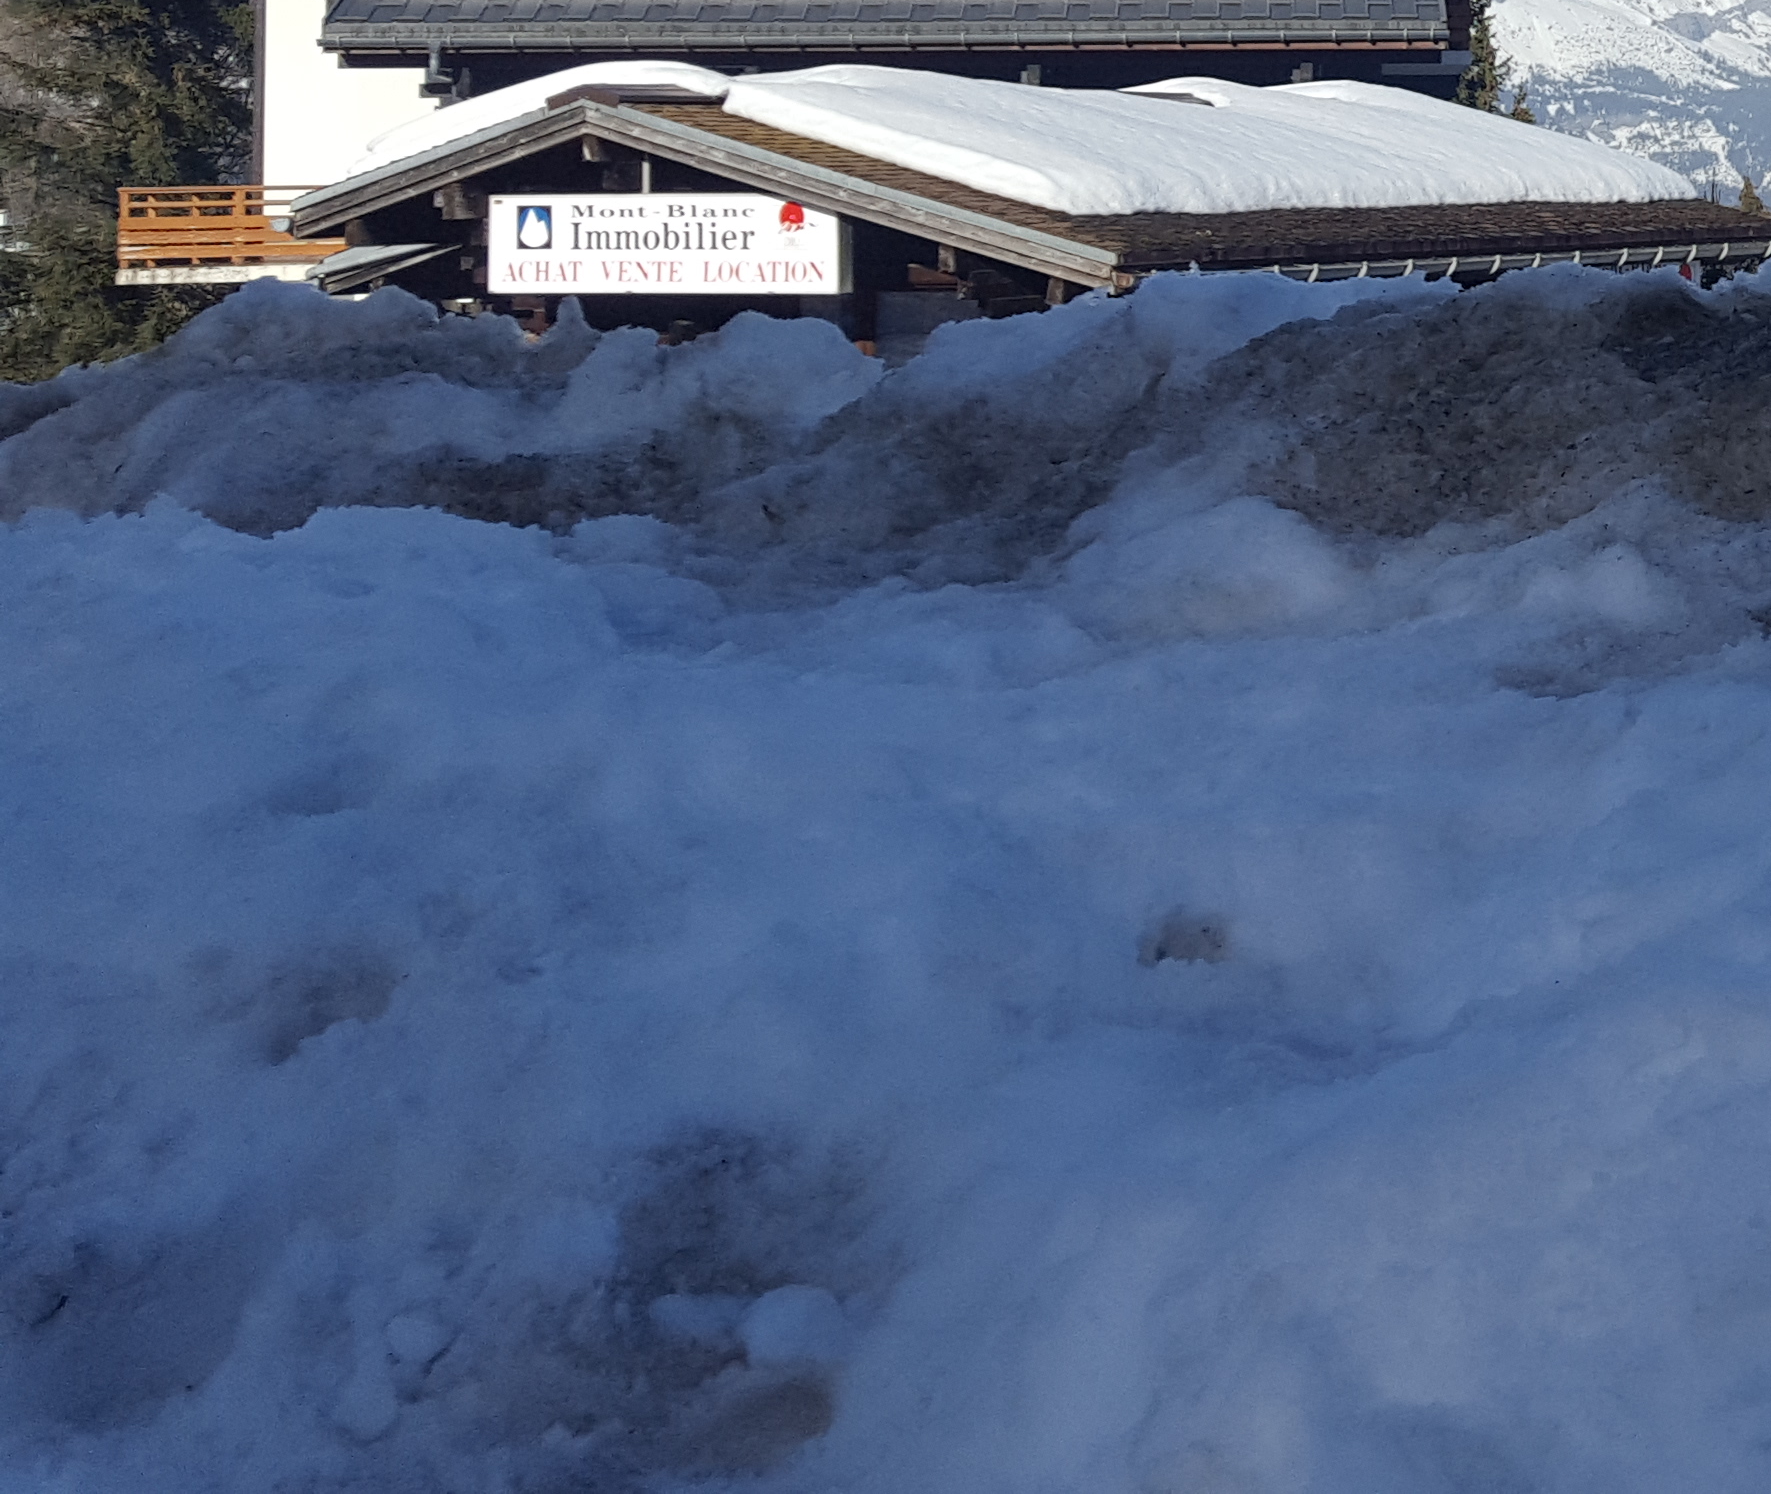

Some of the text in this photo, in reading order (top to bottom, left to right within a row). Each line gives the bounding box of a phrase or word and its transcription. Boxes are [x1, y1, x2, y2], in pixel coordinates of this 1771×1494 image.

[570, 204, 756, 218] Mont-Blanc
[570, 222, 756, 251] Immobilier
[501, 261, 825, 283] ACHAT VENTE LOCATION
